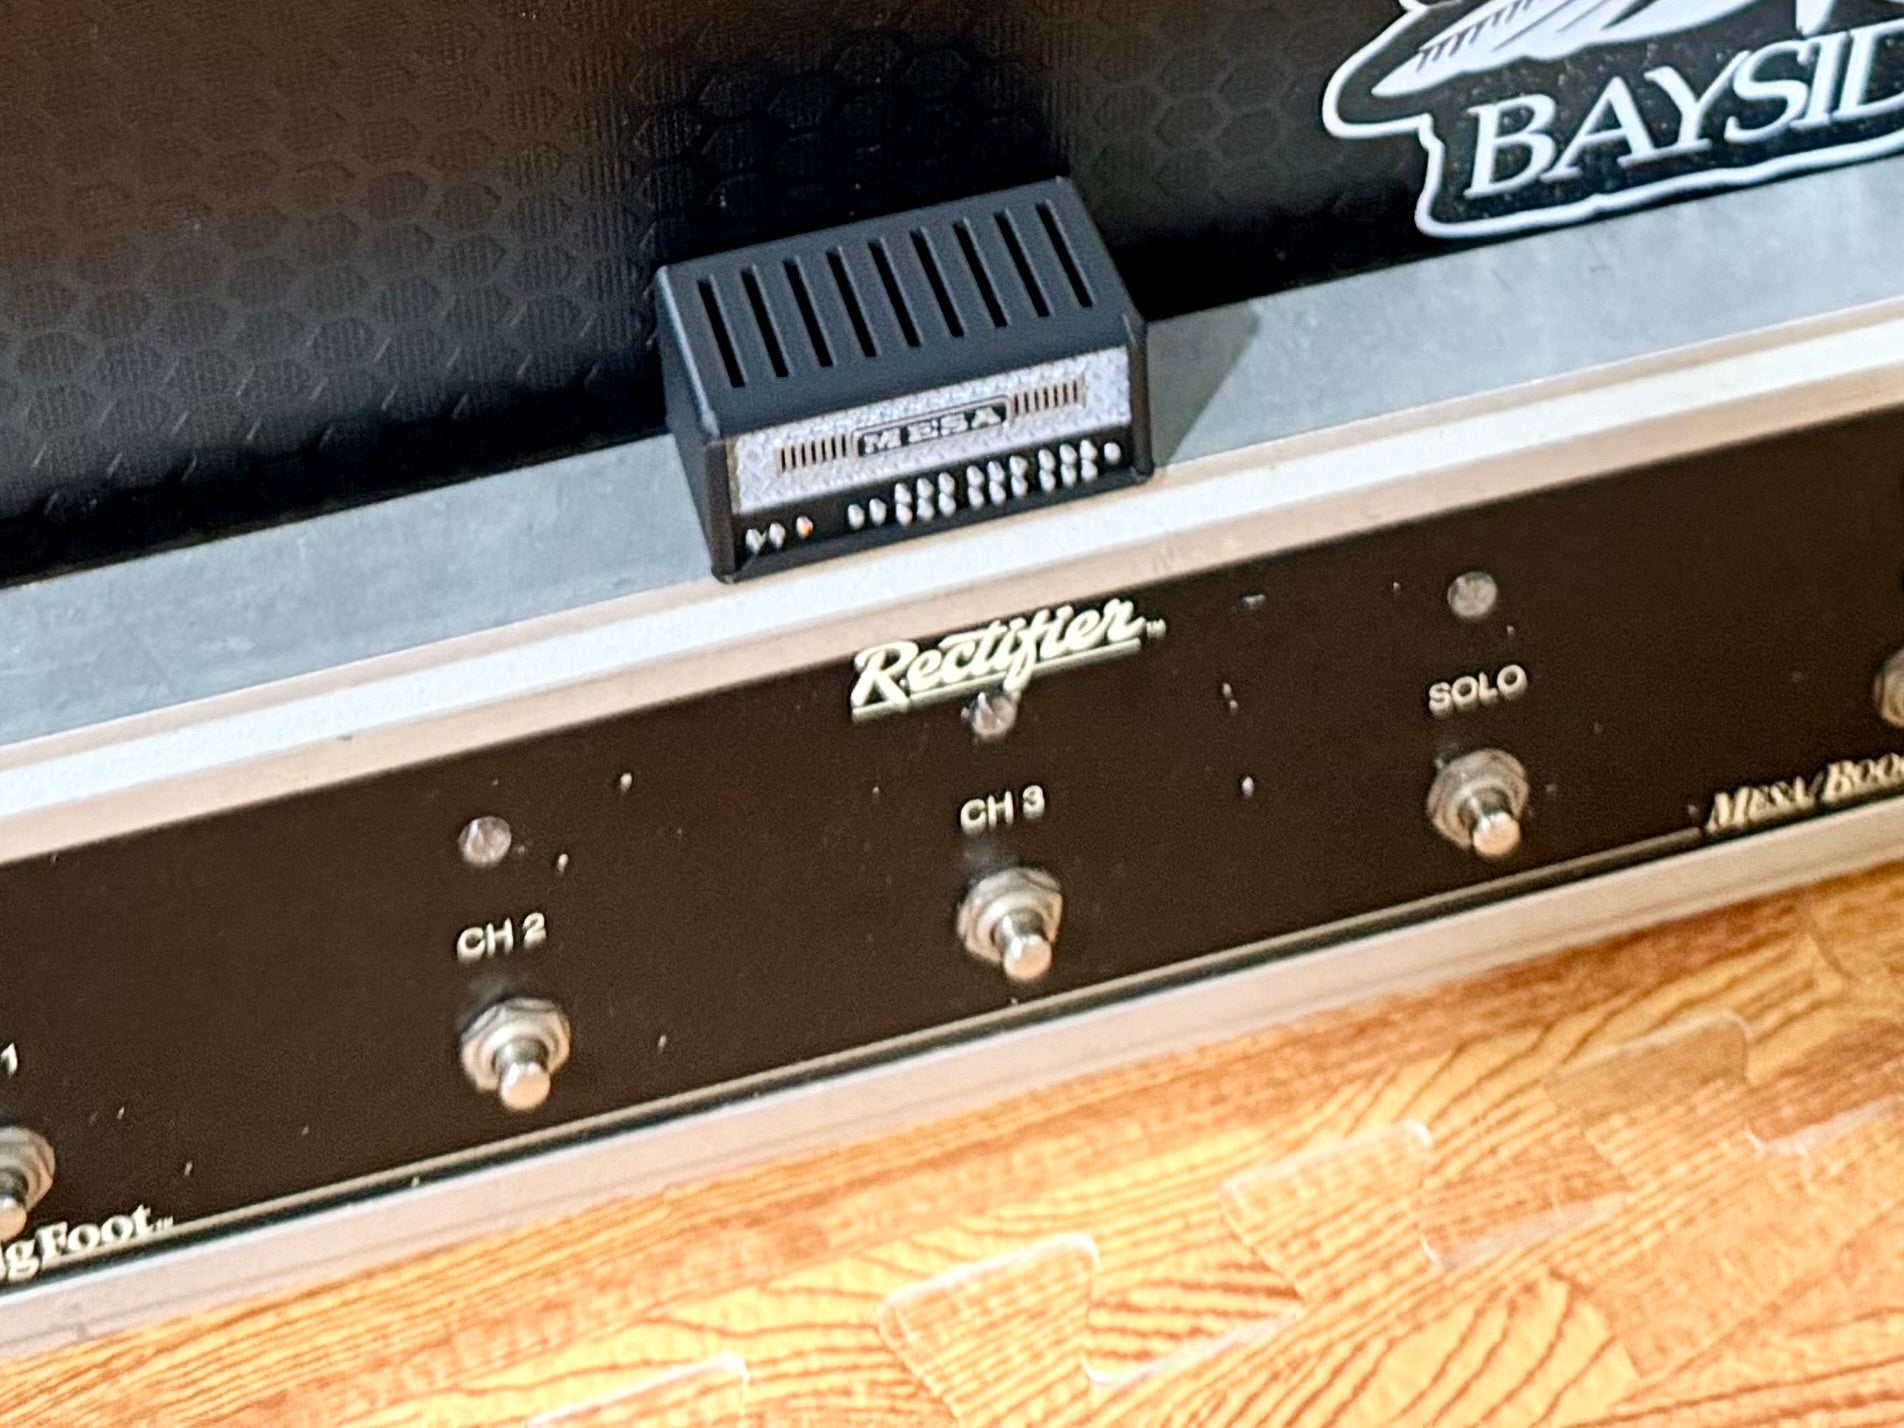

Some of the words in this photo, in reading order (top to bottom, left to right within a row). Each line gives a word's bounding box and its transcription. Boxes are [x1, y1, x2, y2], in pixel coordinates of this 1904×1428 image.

[863, 405, 1005, 455] MESA
[850, 597, 1147, 710] Rectifier
[1427, 663, 1528, 717] SOLO
[960, 790, 1014, 835] CH
[1022, 784, 1045, 821] 3
[456, 917, 514, 963] CH
[522, 910, 548, 949] 2
[0, 1043, 19, 1076] 1
